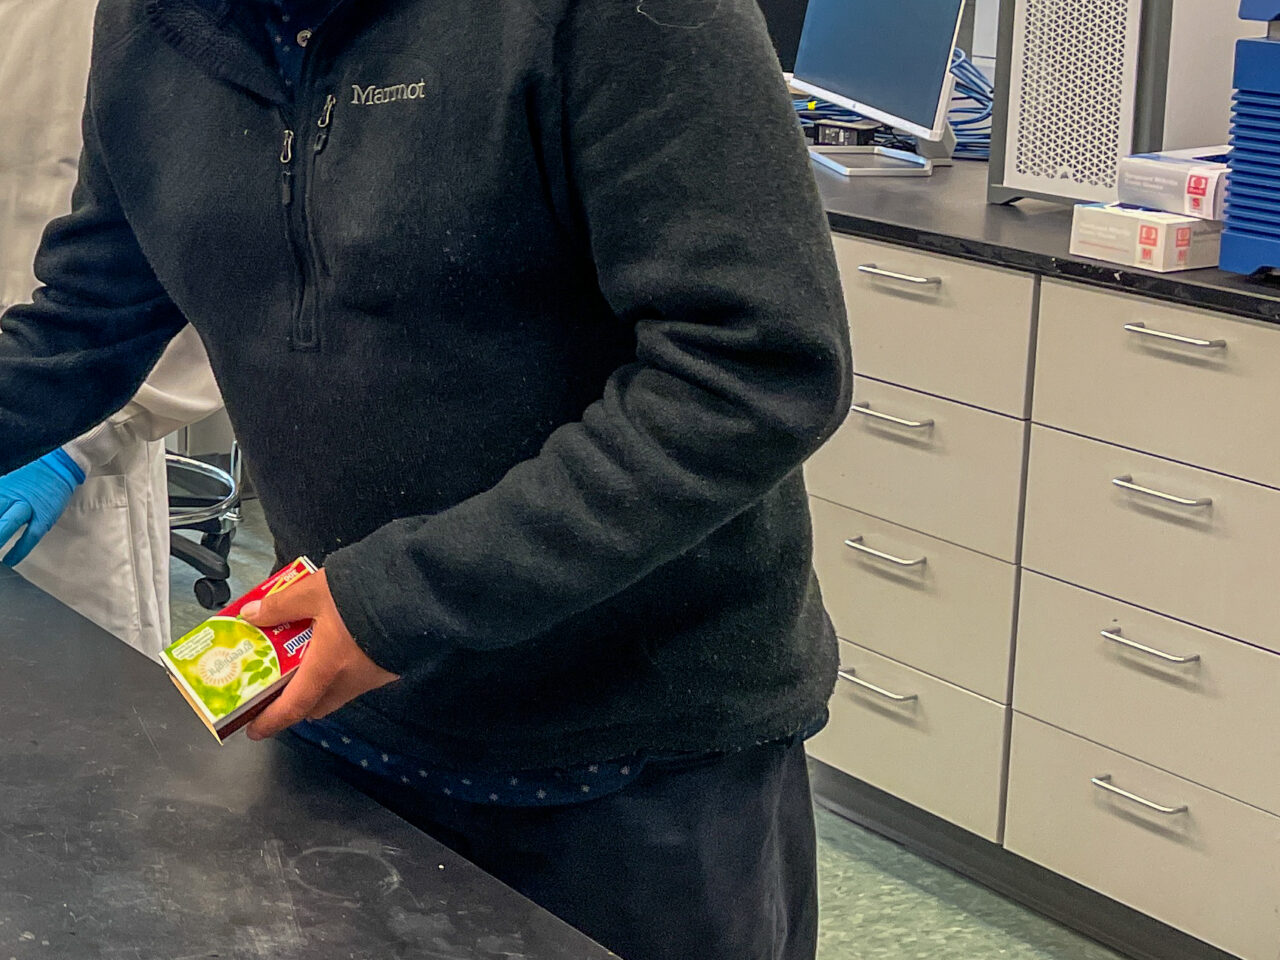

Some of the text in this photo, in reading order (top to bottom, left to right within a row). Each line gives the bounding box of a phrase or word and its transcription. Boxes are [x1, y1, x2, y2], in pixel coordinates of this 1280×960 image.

[351, 78, 426, 105] Marmot
[1192, 197, 1201, 209] S
[286, 629, 313, 654] mond
